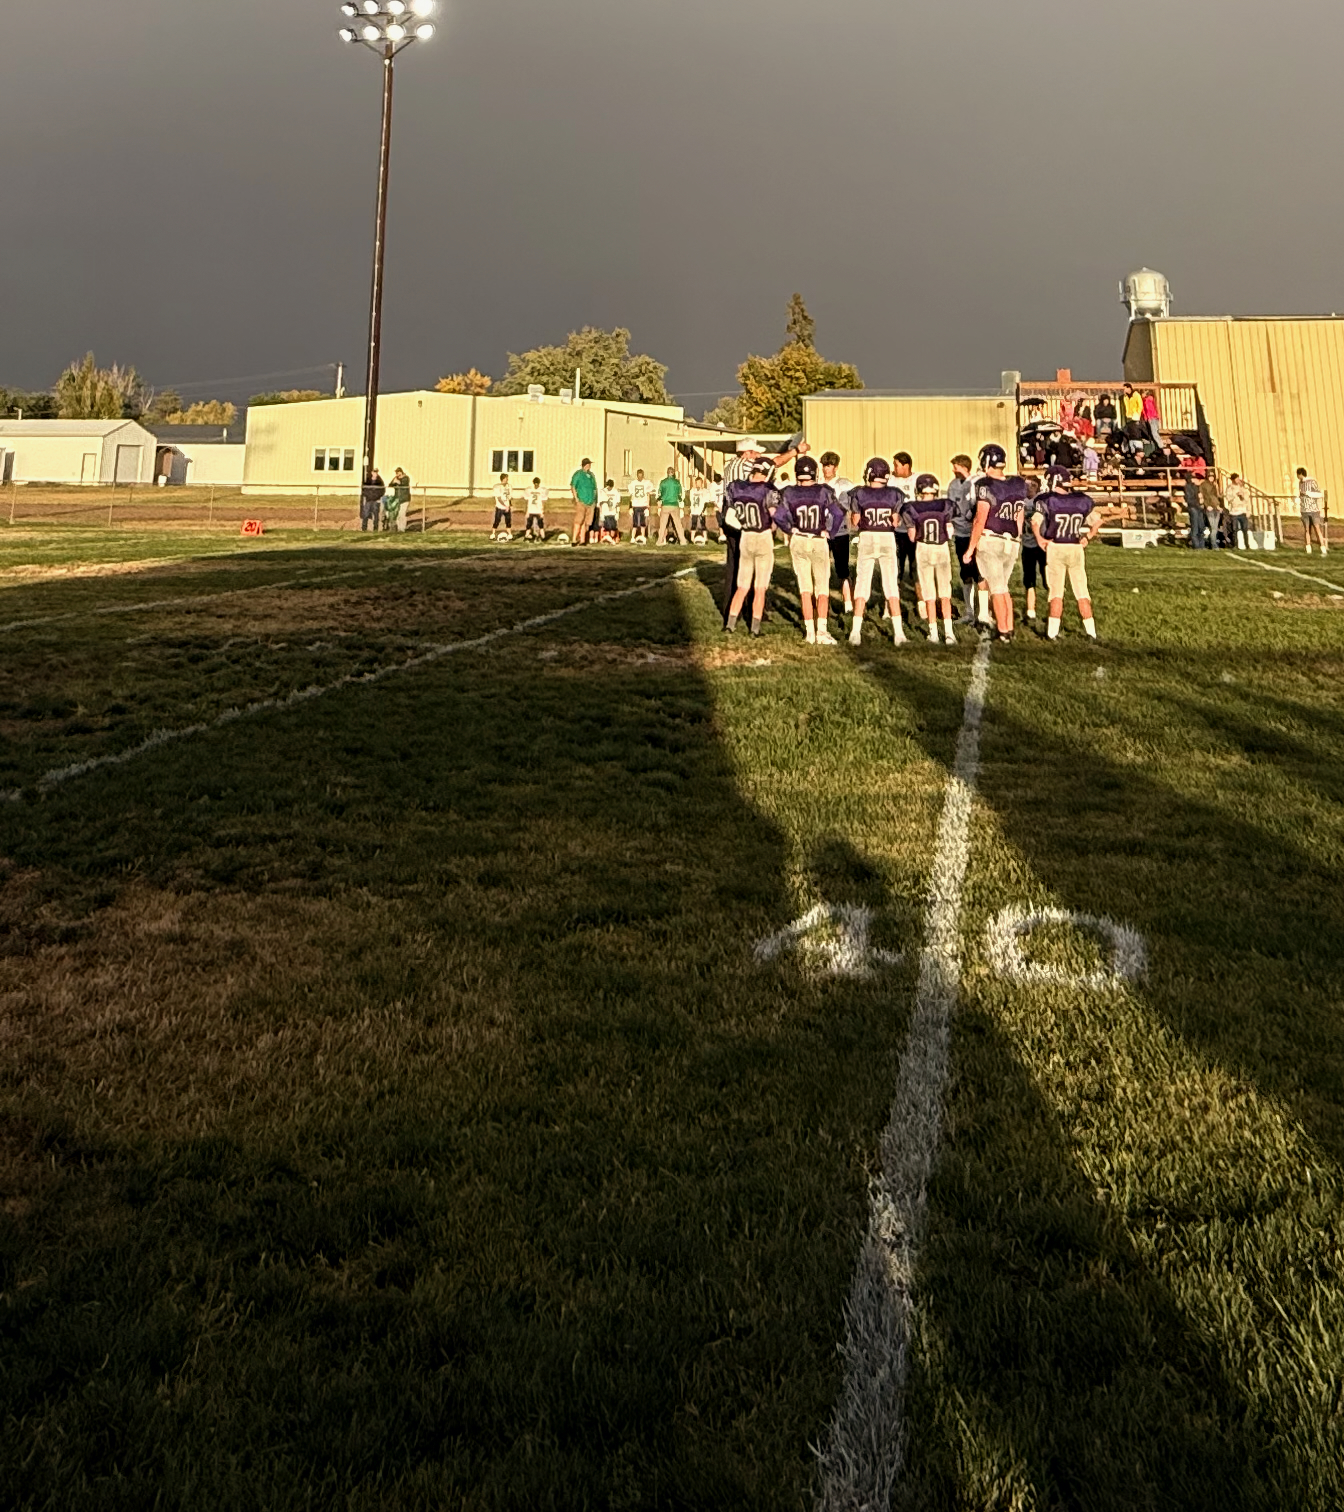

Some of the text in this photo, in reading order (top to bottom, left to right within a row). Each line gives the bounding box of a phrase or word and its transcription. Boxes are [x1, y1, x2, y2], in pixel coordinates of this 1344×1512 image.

[244, 521, 257, 532] 20
[796, 505, 820, 529] 11
[1054, 513, 1084, 539] 70
